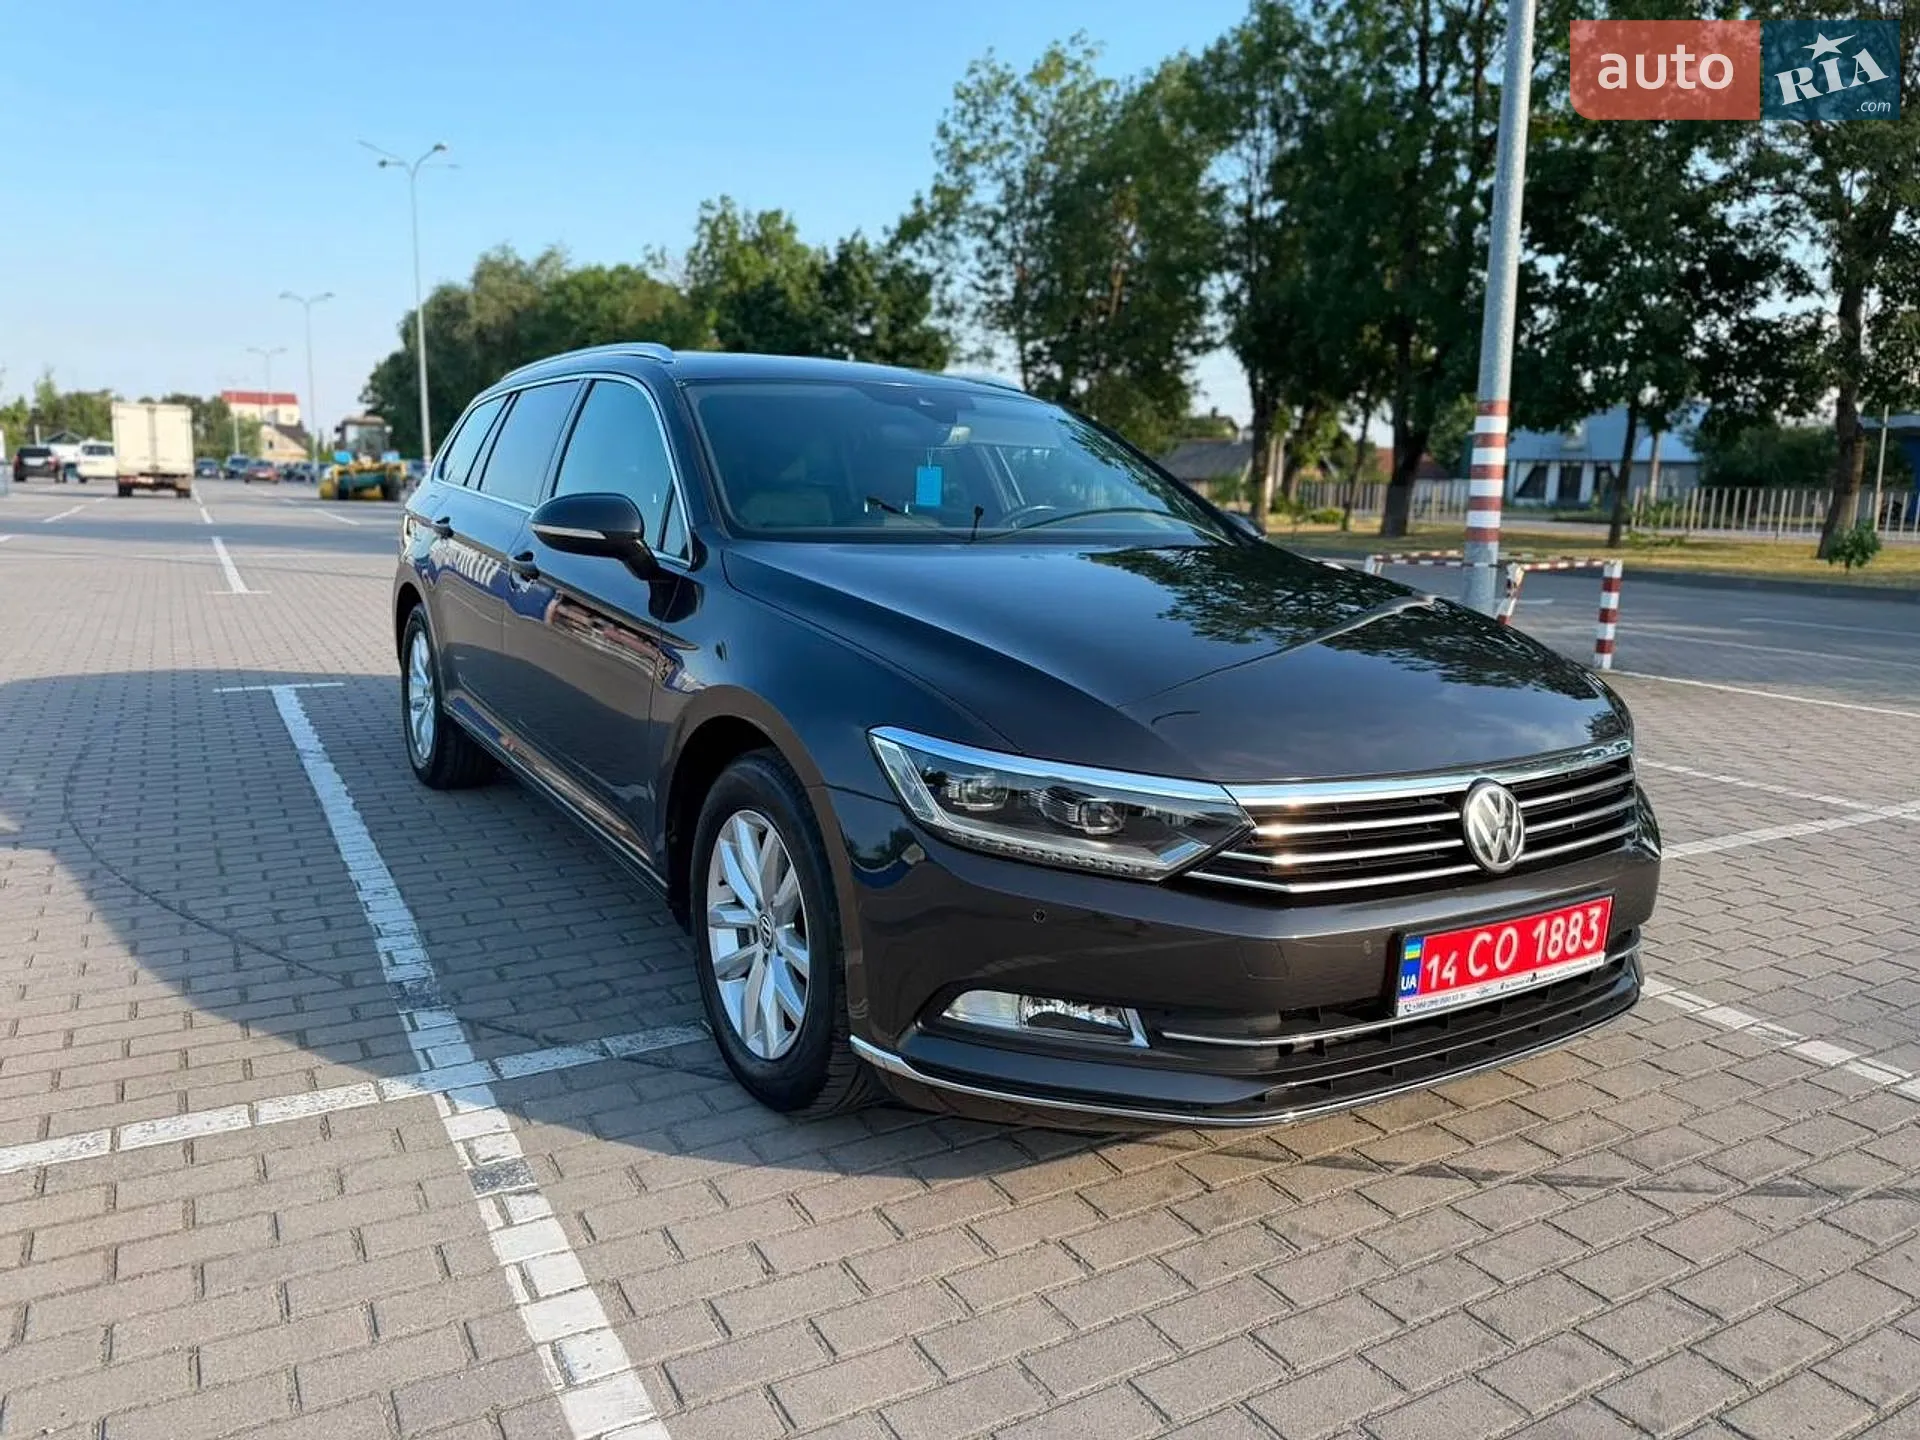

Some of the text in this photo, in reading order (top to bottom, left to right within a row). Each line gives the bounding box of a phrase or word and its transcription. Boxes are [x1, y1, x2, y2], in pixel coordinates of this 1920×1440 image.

[1426, 950, 1459, 990] 14
[1468, 926, 1518, 978] CO
[1532, 905, 1602, 964] 1883
[1400, 974, 1418, 991] UA
